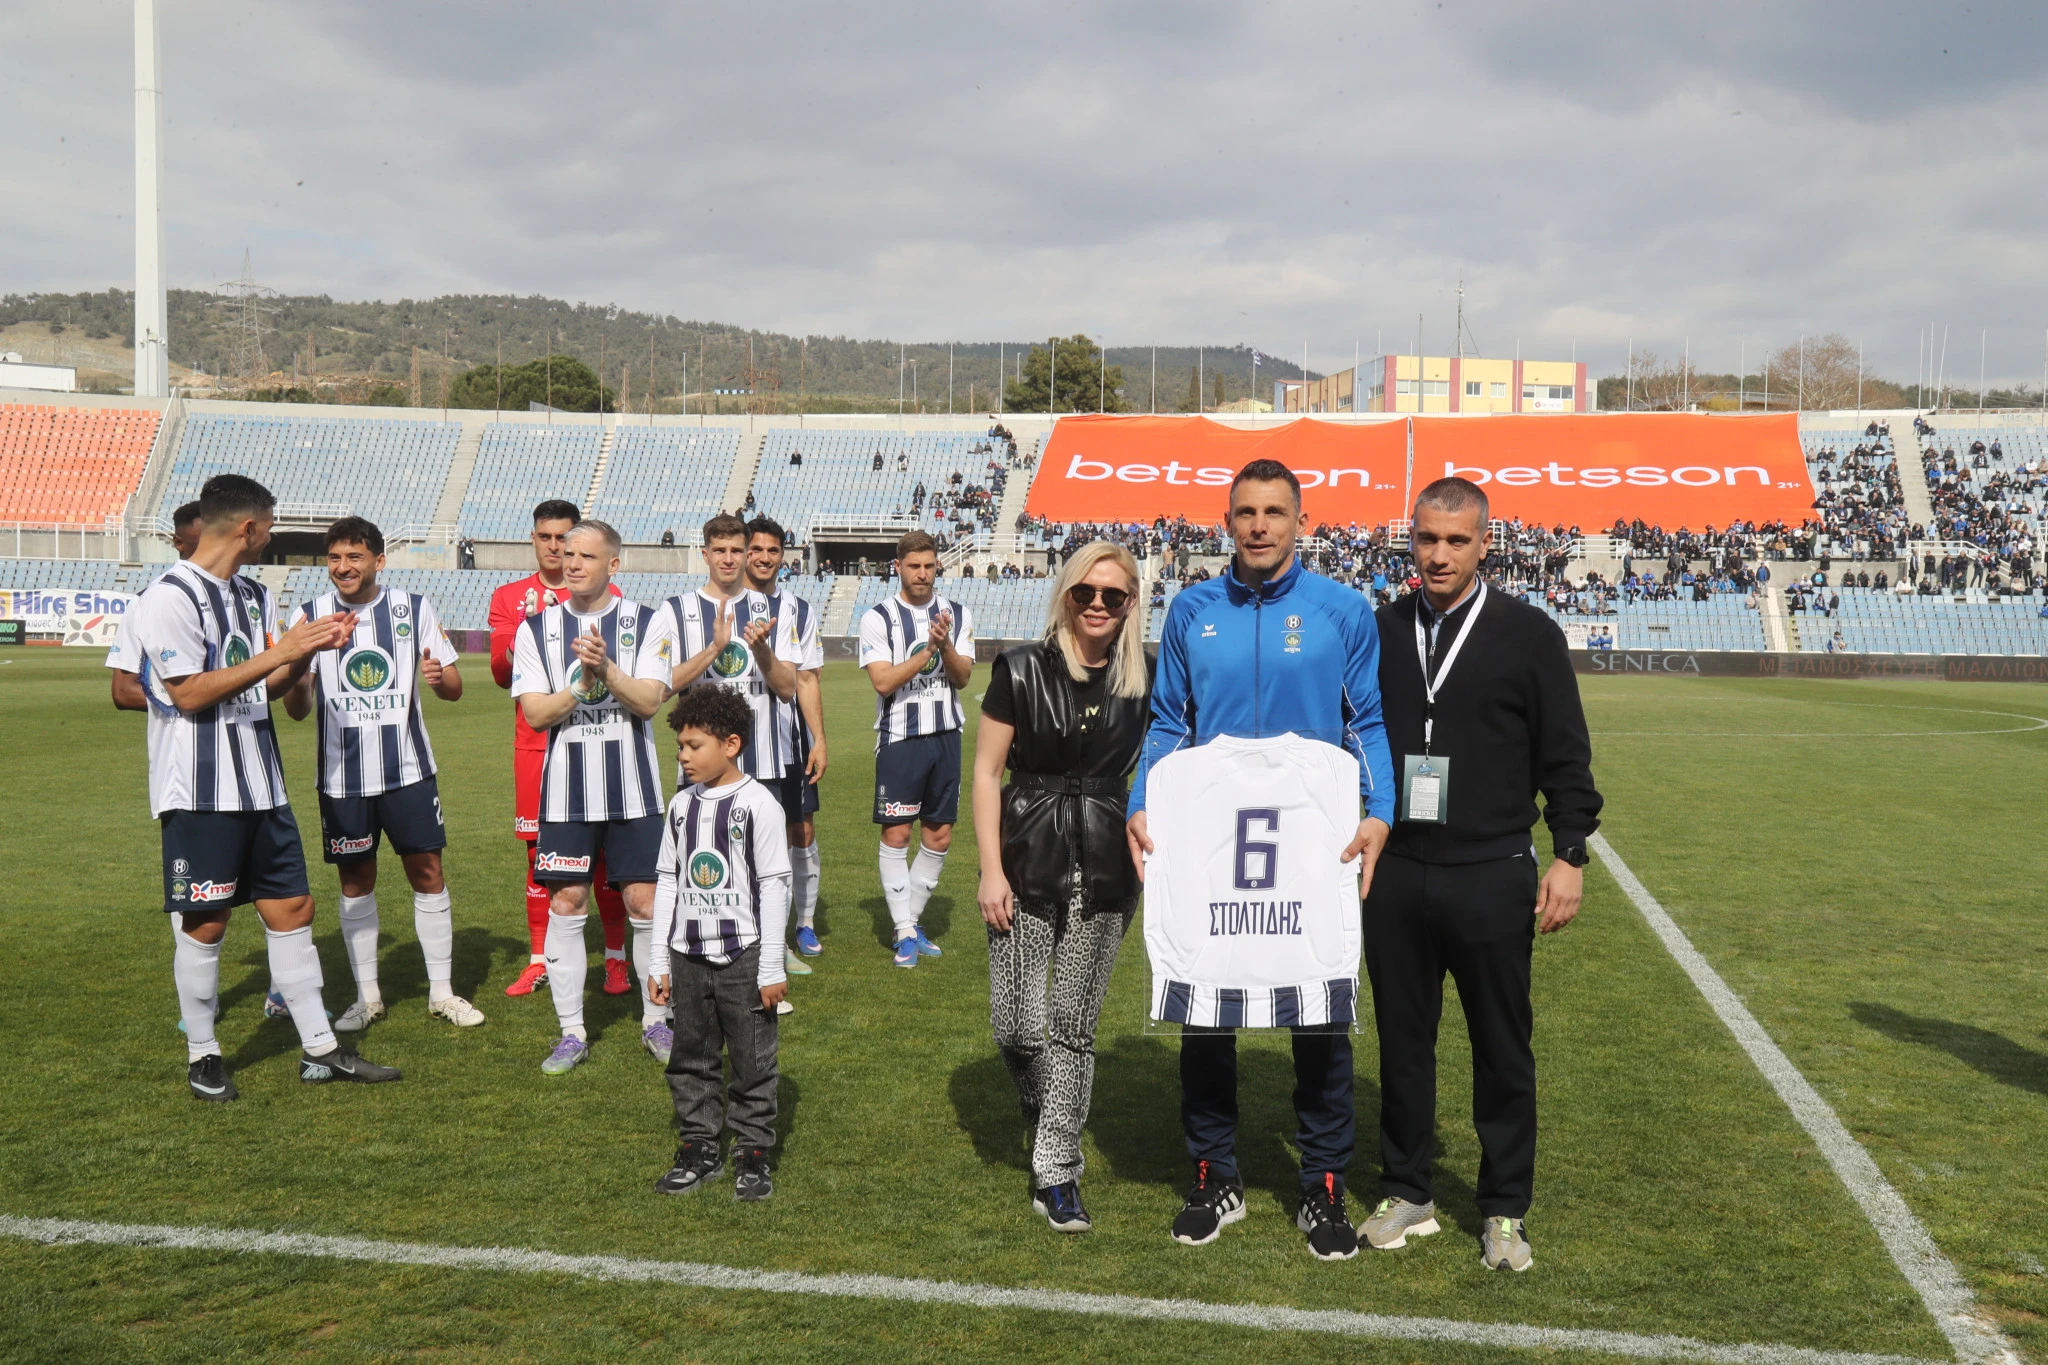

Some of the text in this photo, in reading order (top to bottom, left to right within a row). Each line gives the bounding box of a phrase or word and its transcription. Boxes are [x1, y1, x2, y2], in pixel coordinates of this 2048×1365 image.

[1065, 454, 1370, 488] betson
[1444, 461, 1801, 489] betsson 21+
[75, 593, 130, 614] Sho
[1591, 653, 1700, 672] SENECA
[329, 693, 408, 712] VENETI
[358, 711, 381, 721] 1948
[581, 727, 605, 737] 1948
[1233, 807, 1281, 891] 6
[554, 857, 589, 868] mexil
[682, 892, 740, 907] VENETI
[698, 907, 719, 916] 1948
[1209, 901, 1302, 936] ΣΤΟΛΤΙΔΗΣ
